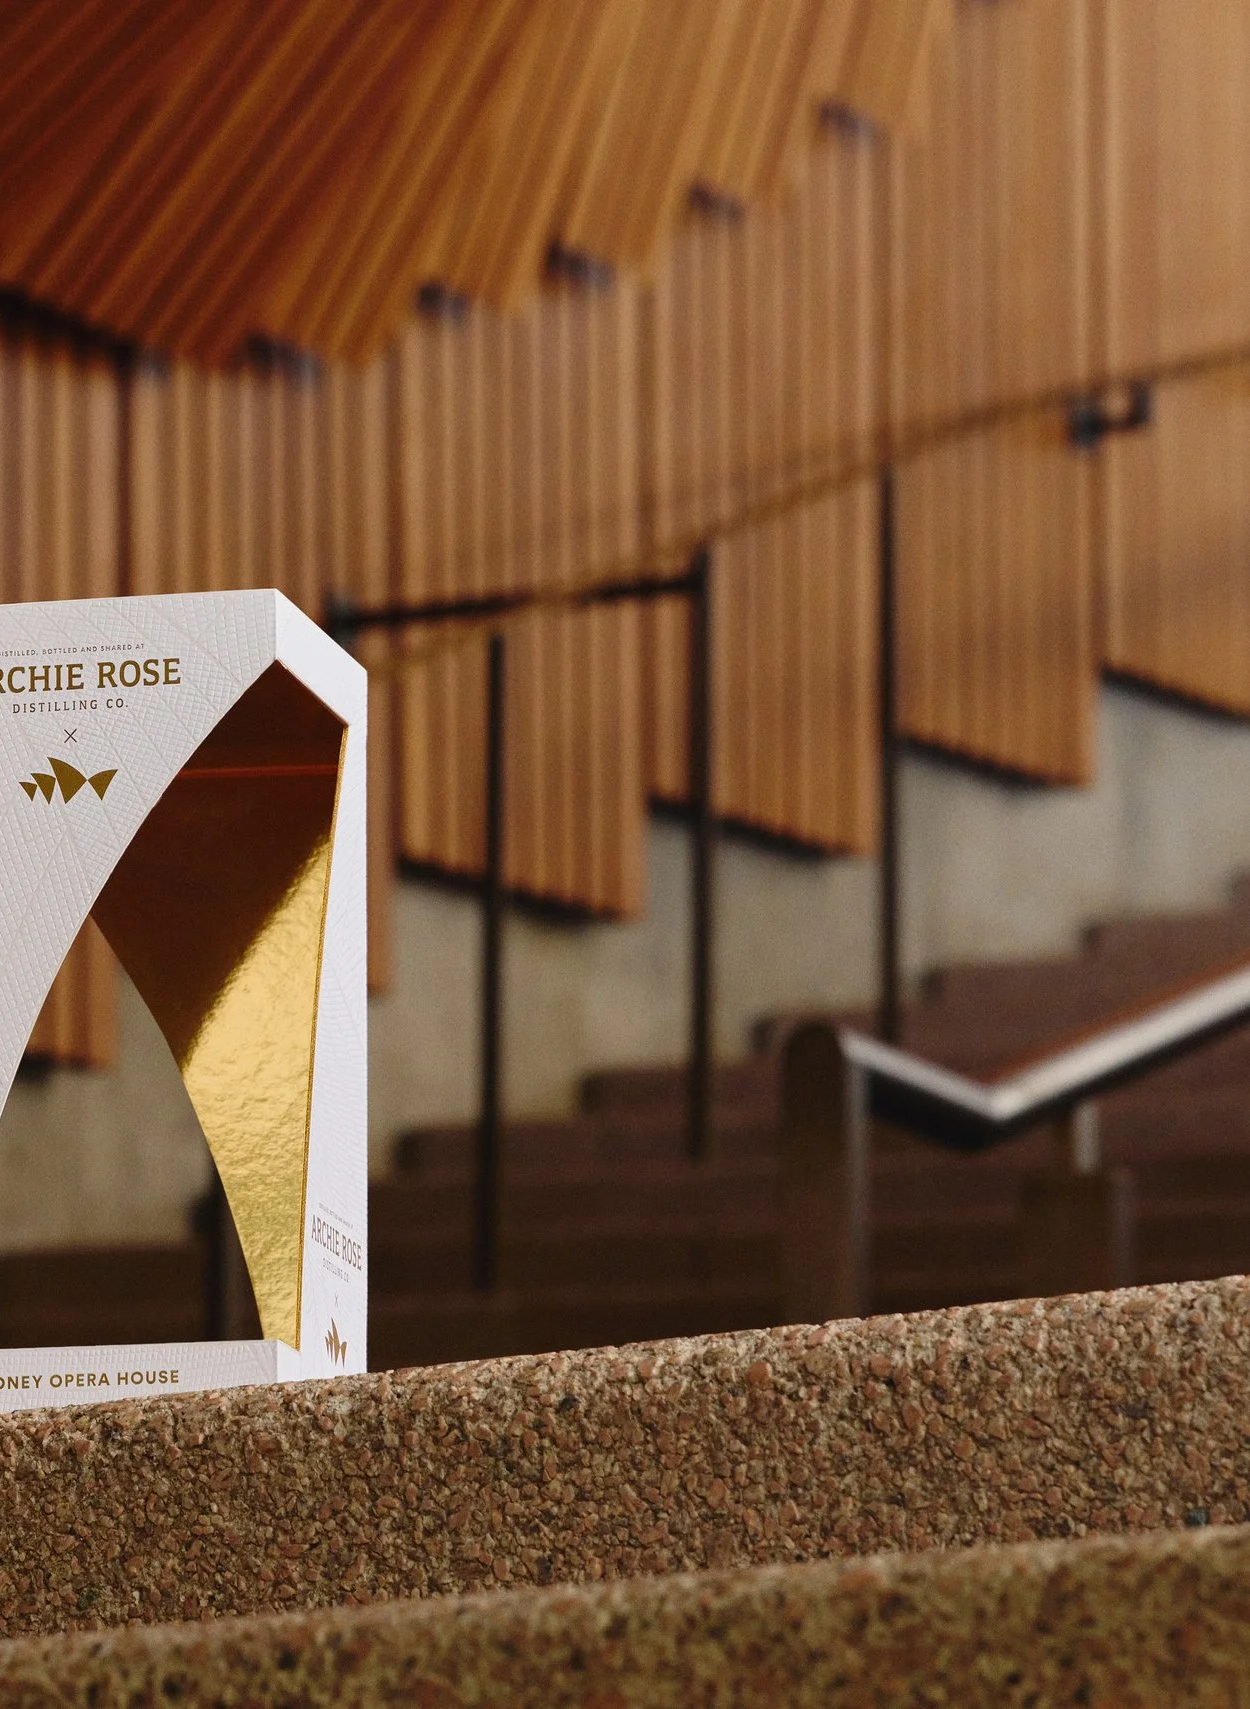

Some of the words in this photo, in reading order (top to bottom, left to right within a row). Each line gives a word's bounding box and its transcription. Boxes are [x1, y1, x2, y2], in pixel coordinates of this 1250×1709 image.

[42, 646, 78, 656] BOTTLED
[81, 645, 98, 653] AND
[101, 643, 132, 652] SHARED
[135, 642, 145, 650] AT
[96, 658, 181, 689] ROSE
[12, 699, 98, 714] DISTILLING
[106, 698, 129, 709] CO.
[311, 1214, 340, 1257] ARCHIE
[342, 1234, 362, 1271] ROSE
[49, 1372, 110, 1389] OPERA
[117, 1370, 180, 1386] HOUSE
